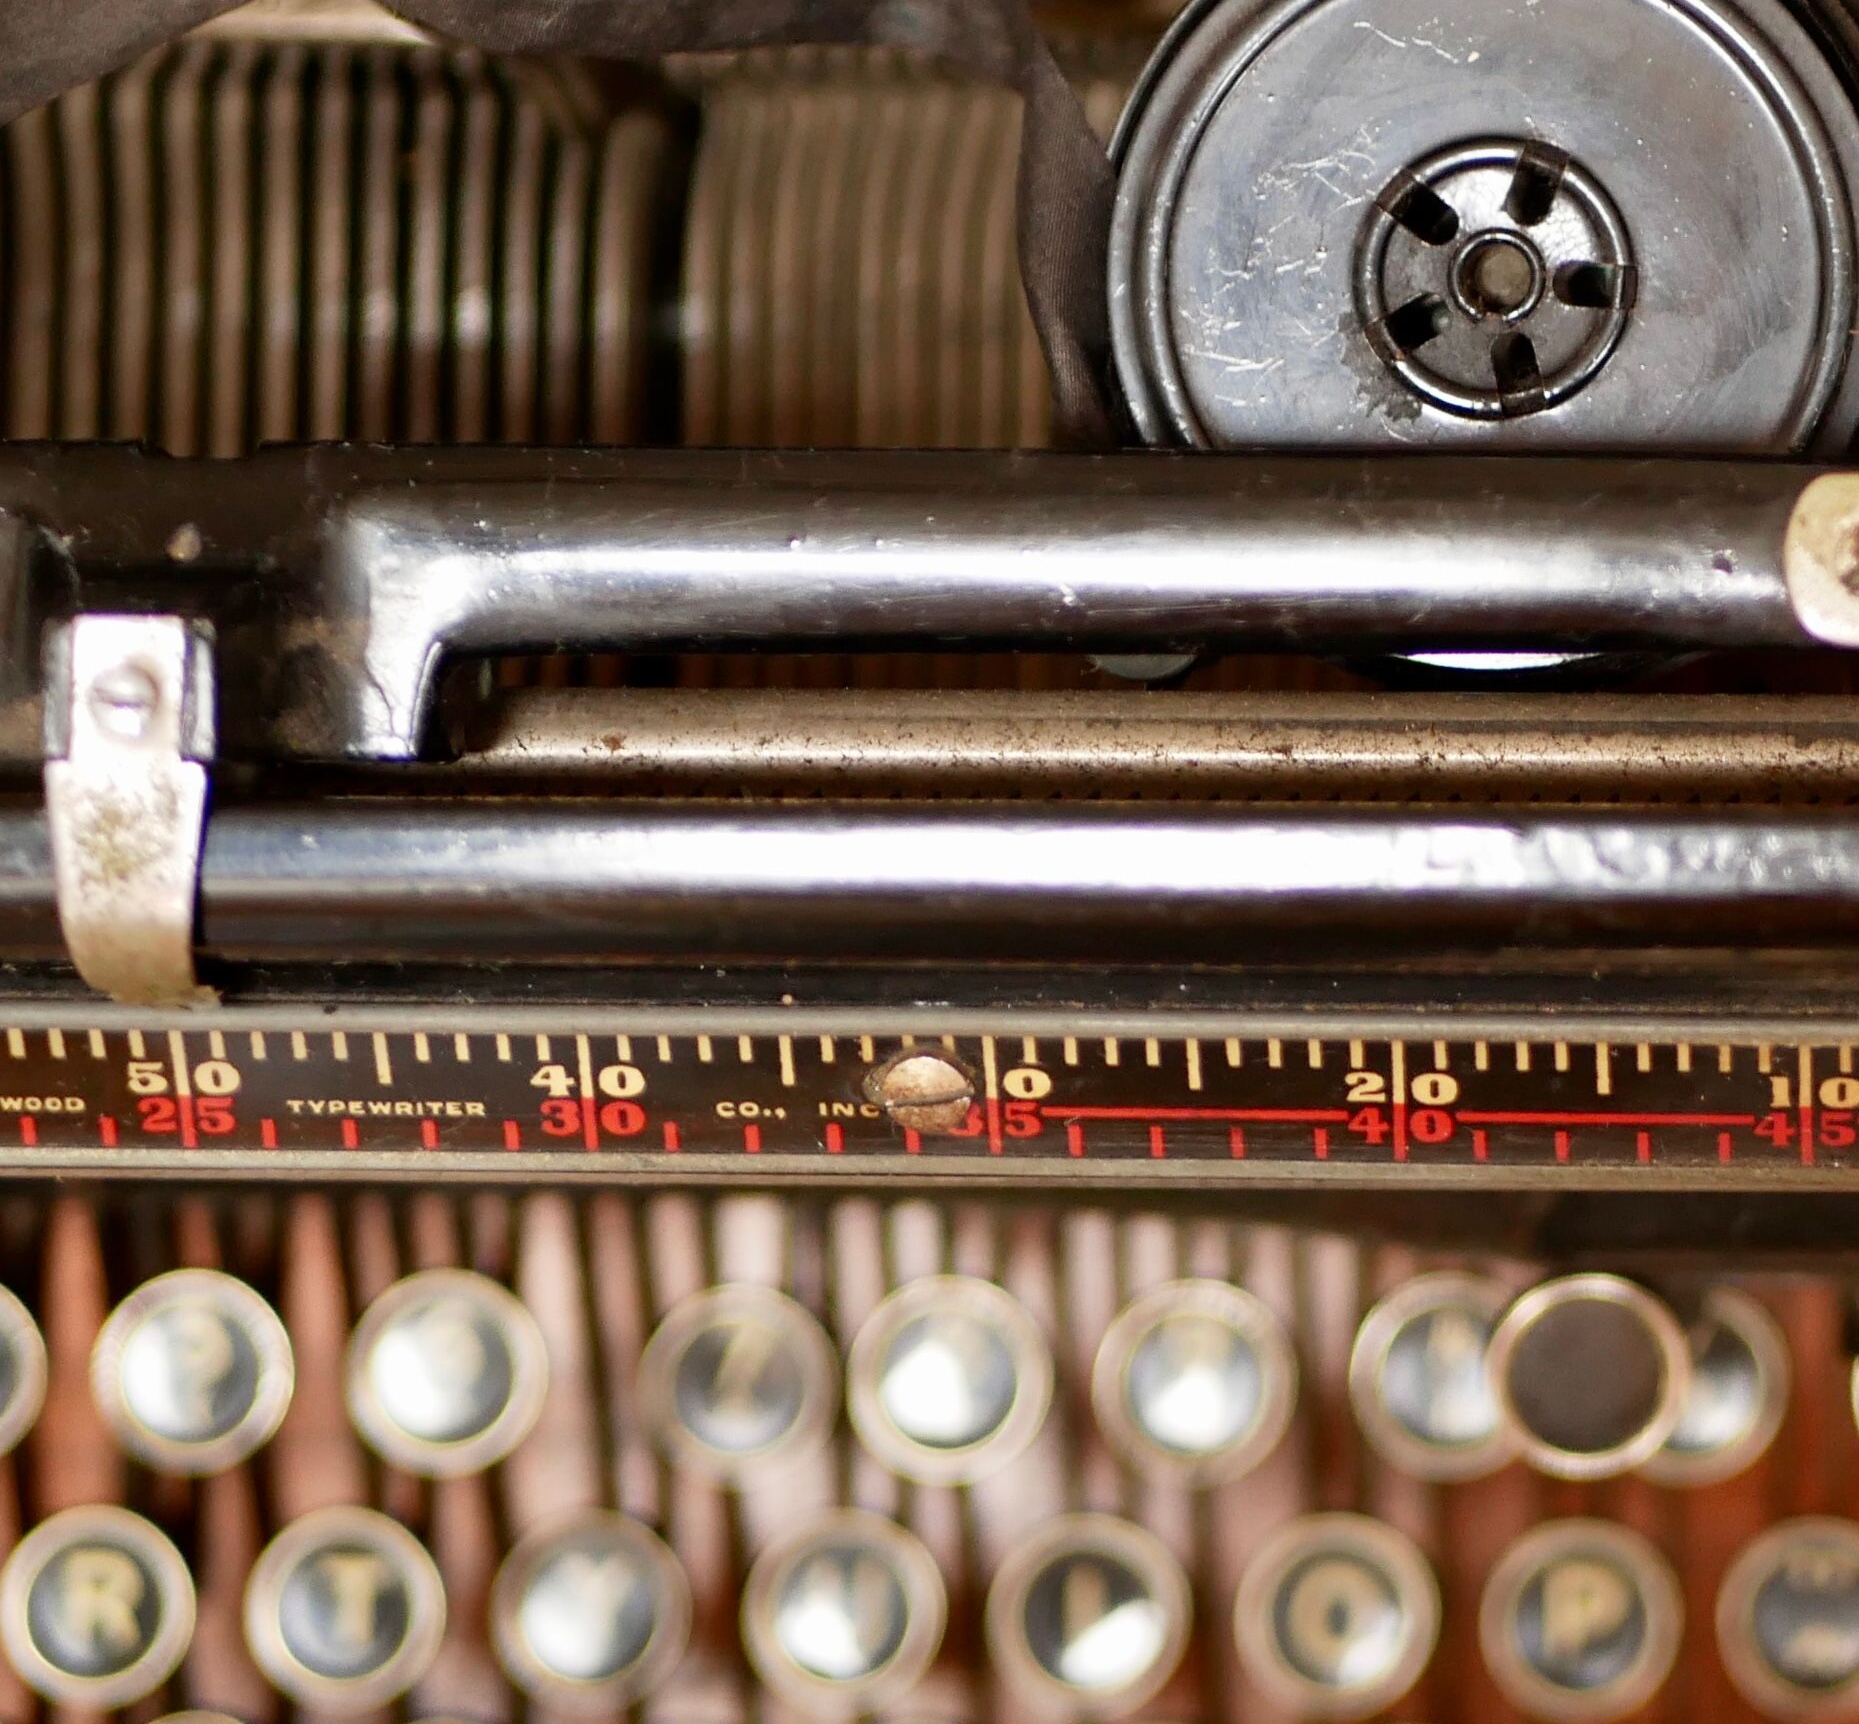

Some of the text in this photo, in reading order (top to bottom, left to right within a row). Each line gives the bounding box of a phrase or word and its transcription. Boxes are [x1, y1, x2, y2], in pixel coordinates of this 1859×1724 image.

[127, 1060, 241, 1095] 50
[530, 1064, 646, 1097] 40
[1345, 1072, 1459, 1105] 20
[137, 1096, 236, 1133] 25
[540, 1099, 646, 1136] 30
[1347, 1105, 1453, 1144] 40
[1753, 1110, 1857, 1147] 45
[287, 1099, 486, 1118] TYPEWRITER
